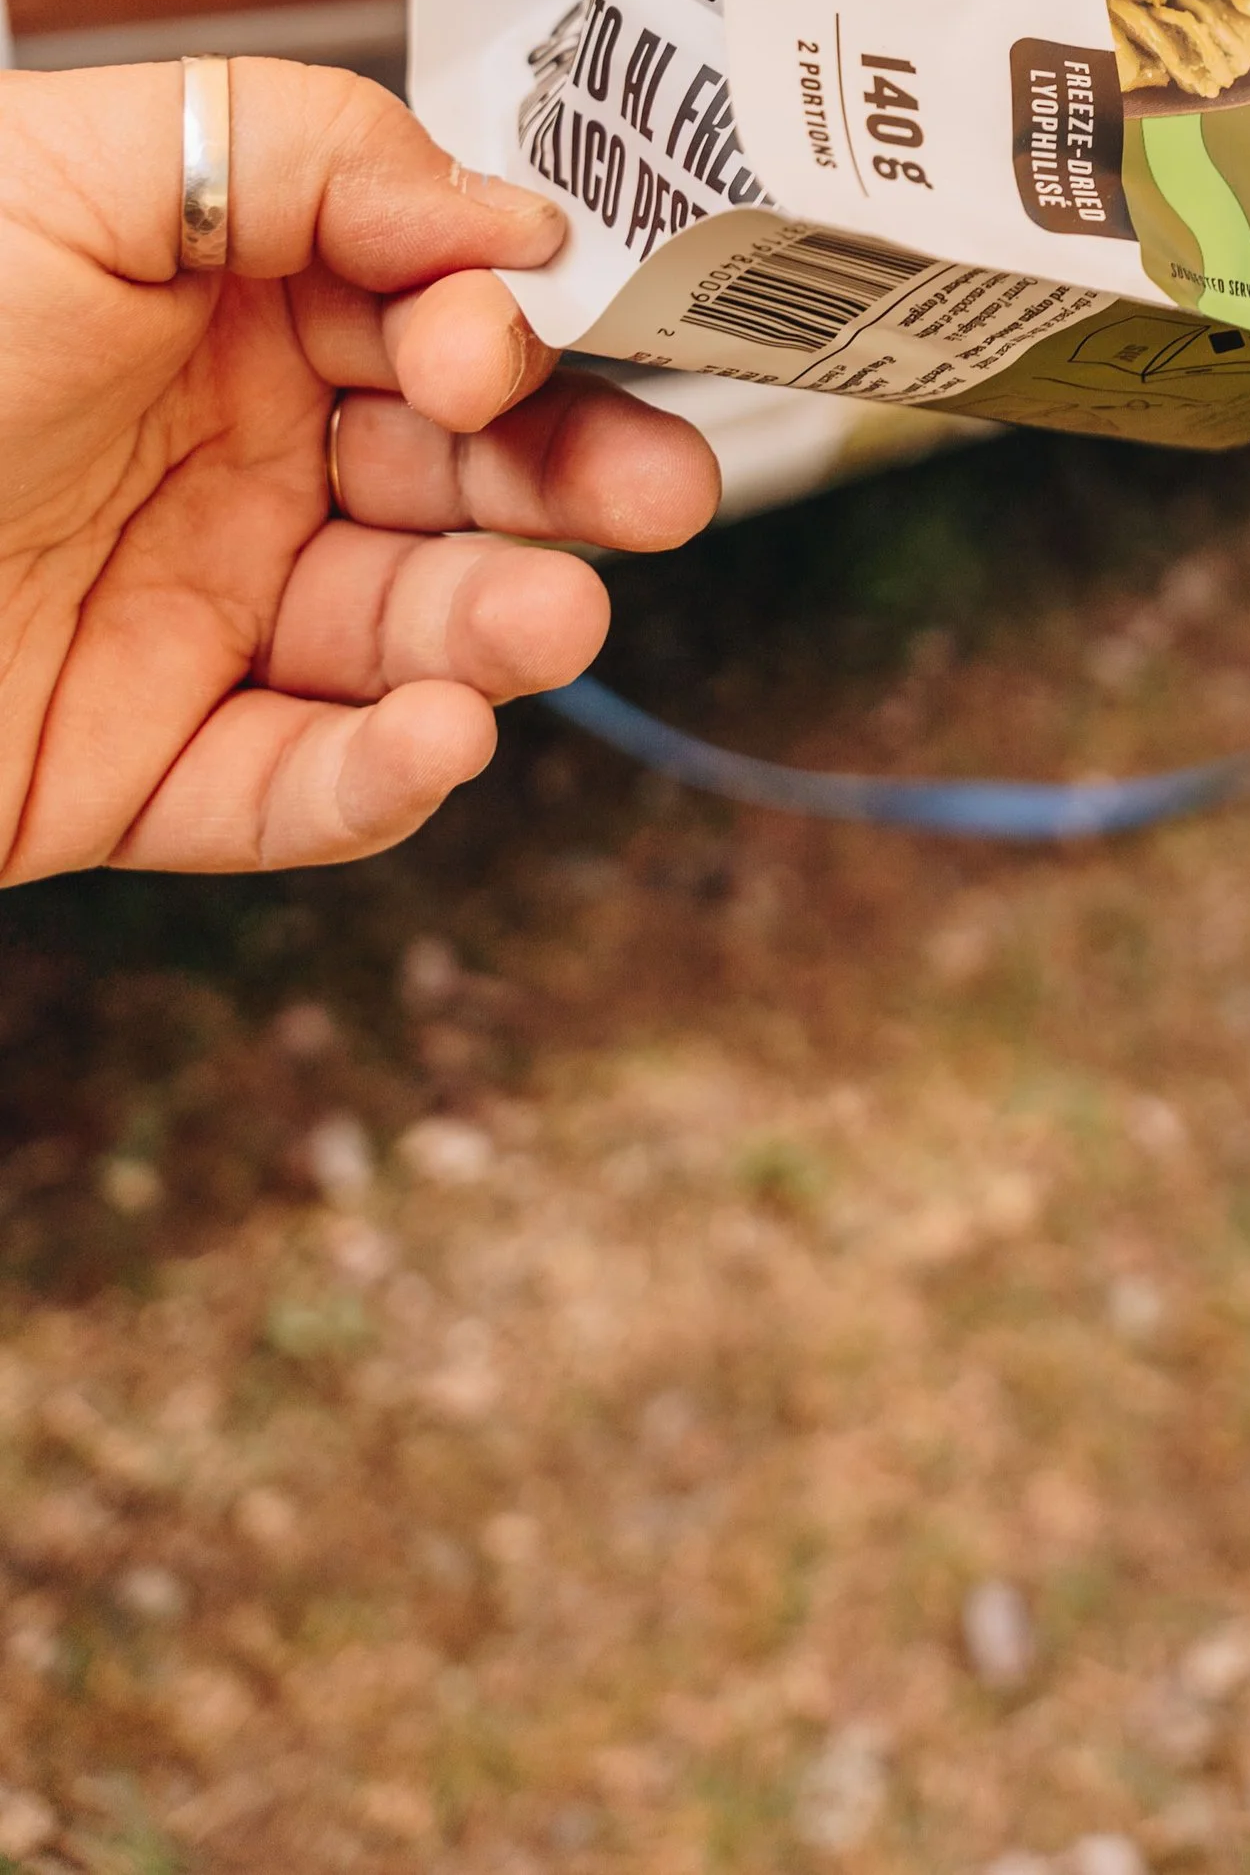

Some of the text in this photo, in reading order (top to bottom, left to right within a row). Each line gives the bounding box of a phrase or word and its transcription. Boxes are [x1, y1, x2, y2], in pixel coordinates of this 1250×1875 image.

[620, 27, 678, 143] AL
[797, 39, 838, 171] 2 PORTIONS
[1029, 68, 1073, 209] LYOPHILISÉ
[1063, 60, 1107, 223] FREEZE-DRIED
